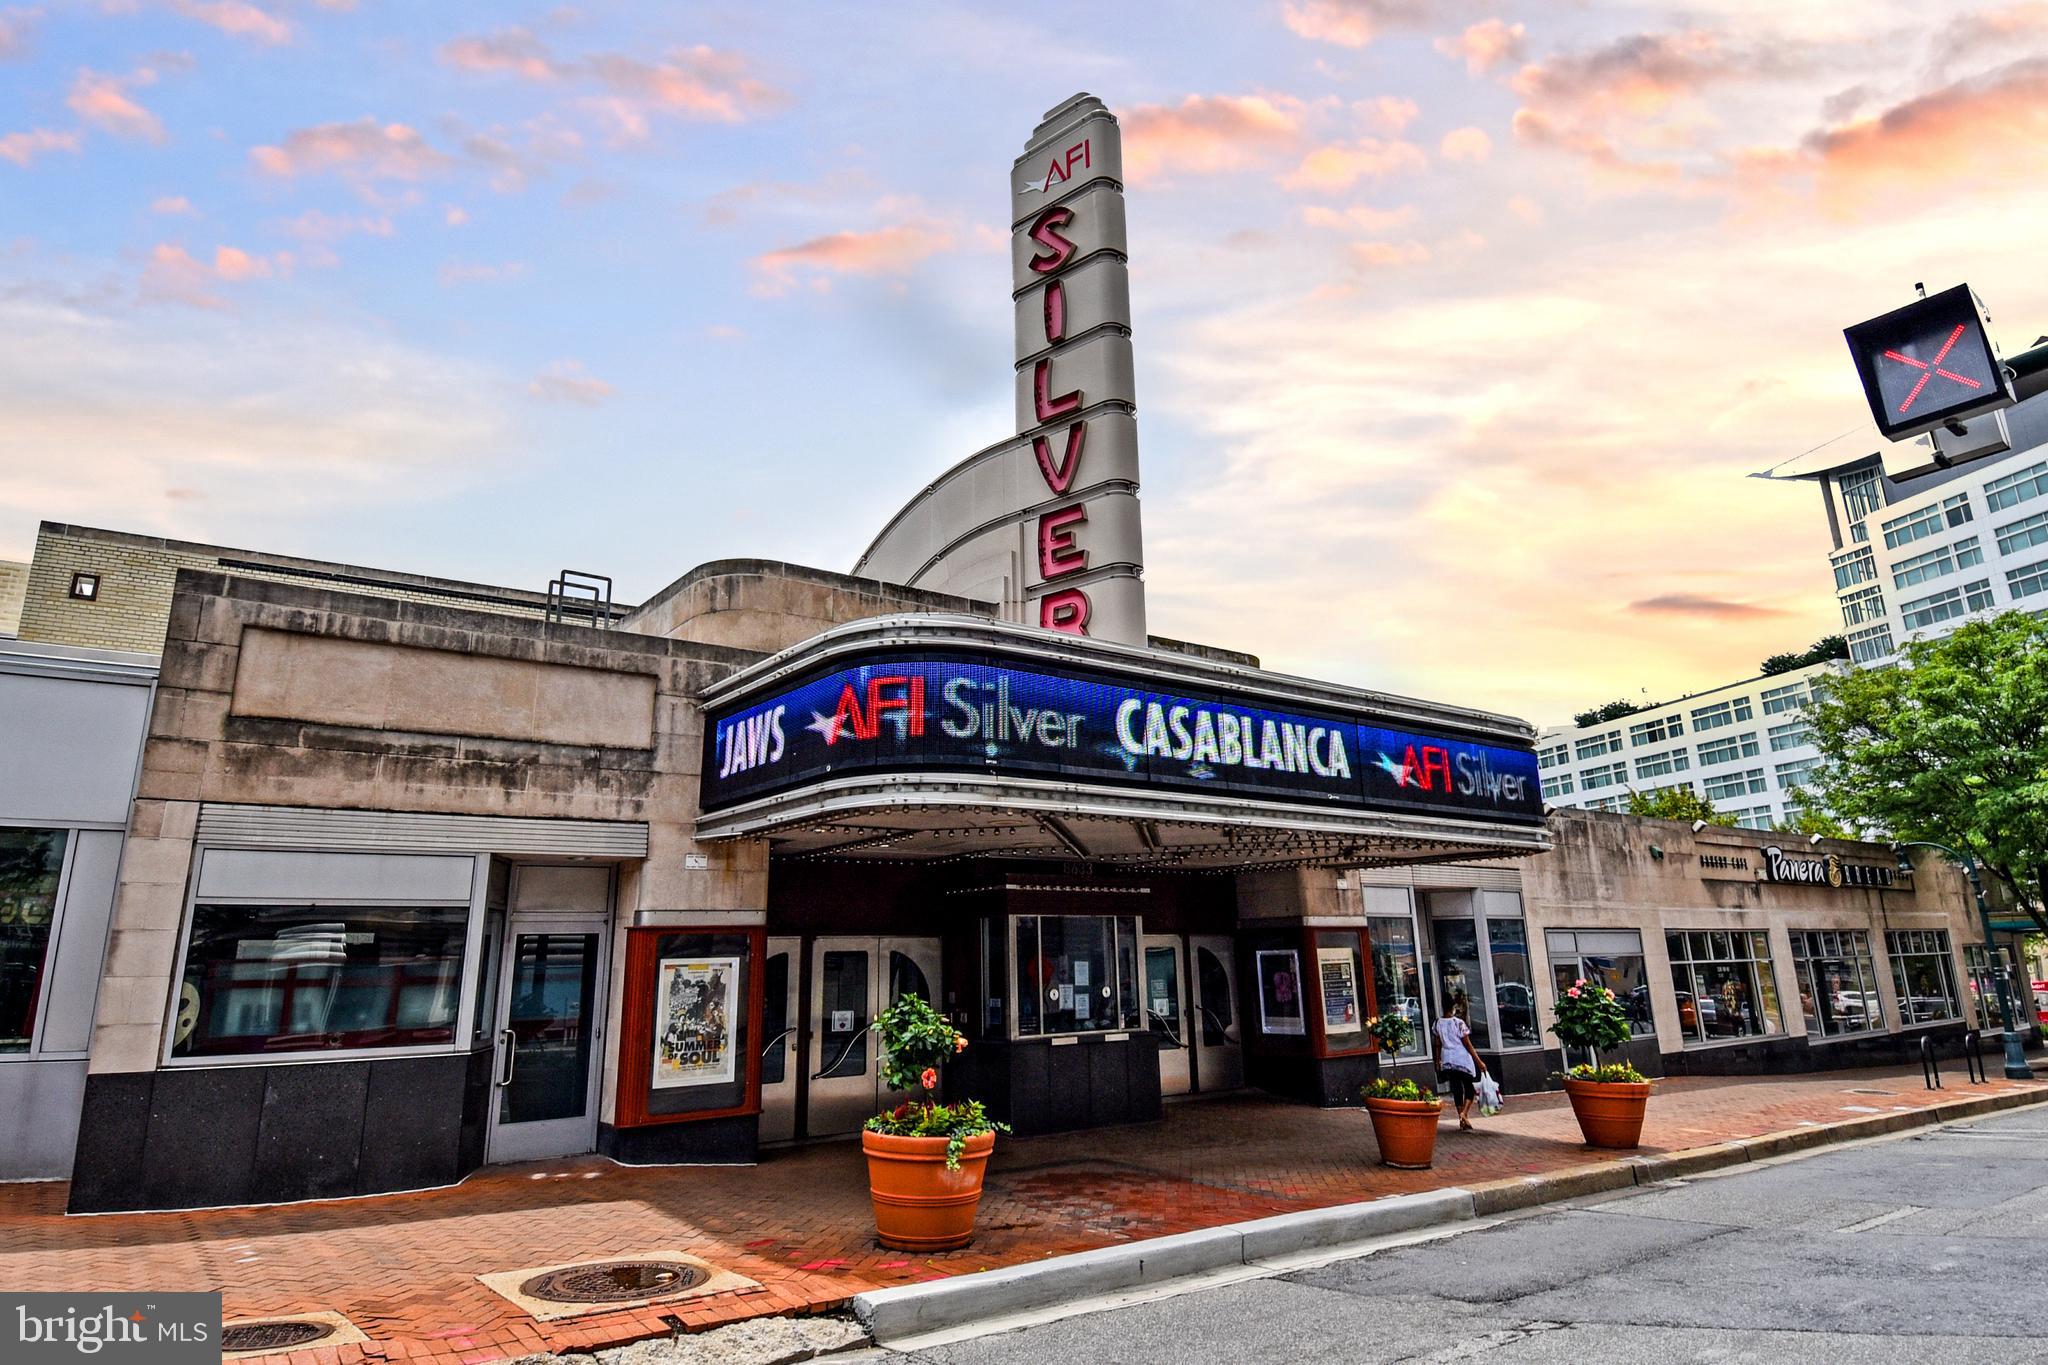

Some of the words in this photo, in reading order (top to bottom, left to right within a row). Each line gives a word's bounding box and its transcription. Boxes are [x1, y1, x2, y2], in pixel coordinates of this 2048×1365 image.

[1043, 139, 1091, 193] AFI
[1028, 206, 1092, 637] SILVER
[826, 676, 924, 745] AFI
[941, 675, 1086, 749] Silver
[1116, 699, 1352, 779] CASABLANCA
[720, 705, 785, 780] JAWS
[1400, 744, 1453, 793] AFI
[1457, 749, 1527, 800] Silver
[1766, 846, 1826, 883] Panera
[1845, 865, 1893, 886] BREAD
[667, 1041, 721, 1052] SUMMER
[680, 1050, 720, 1065] SOUL
